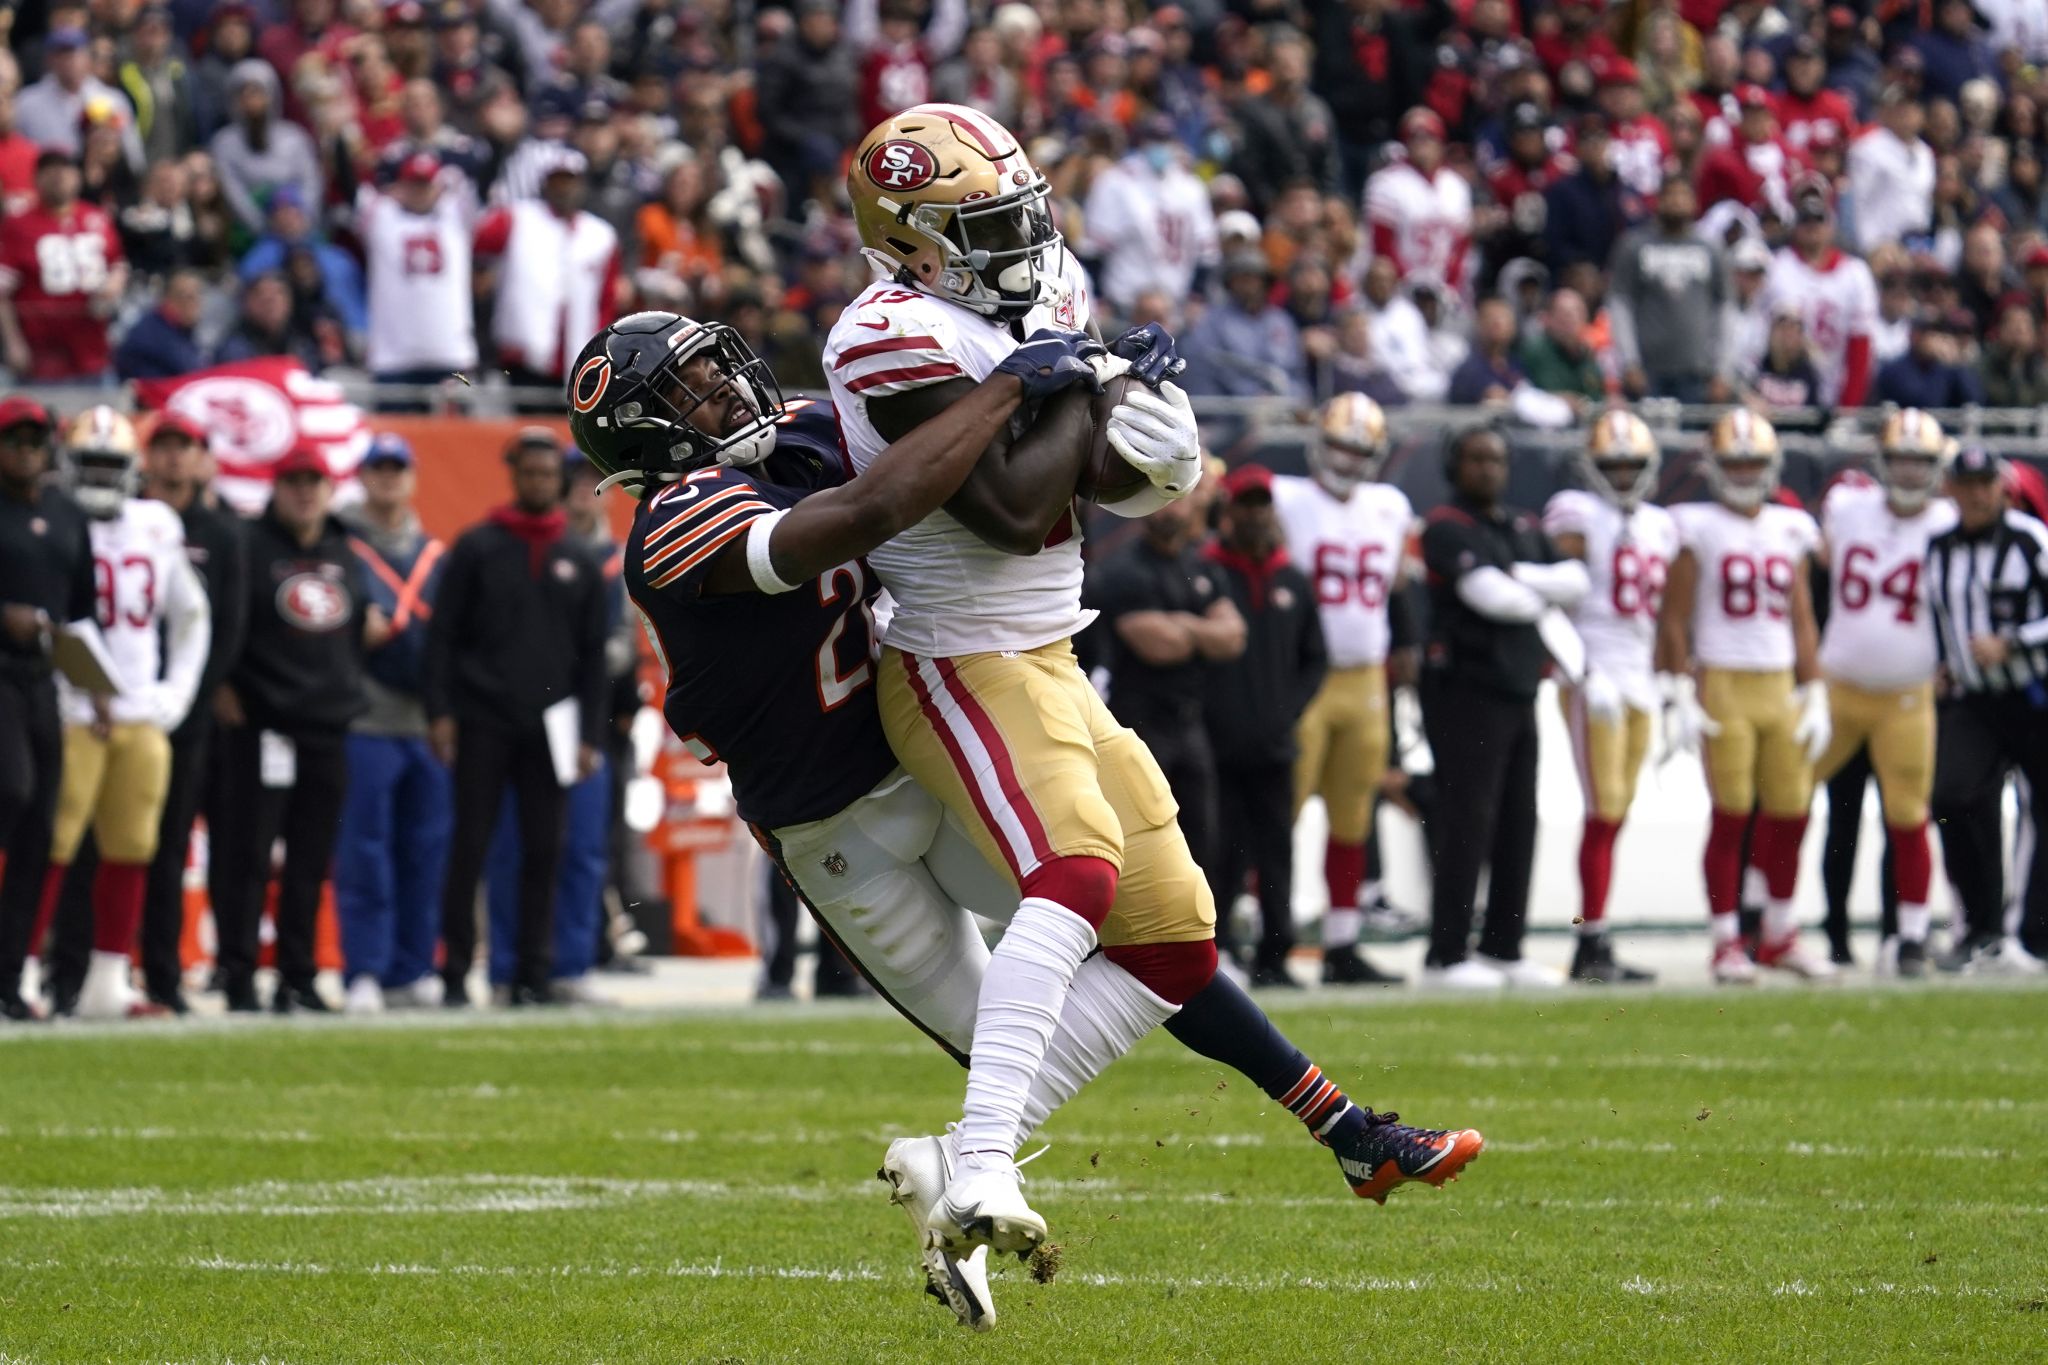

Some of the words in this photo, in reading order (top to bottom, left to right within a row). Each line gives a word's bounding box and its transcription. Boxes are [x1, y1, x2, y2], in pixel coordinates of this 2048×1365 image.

[1313, 542, 1388, 609] 66
[1720, 554, 1794, 620] 89
[1840, 545, 1924, 623] 64
[815, 557, 880, 713] 2
[1340, 1156, 1374, 1181] NIKE
